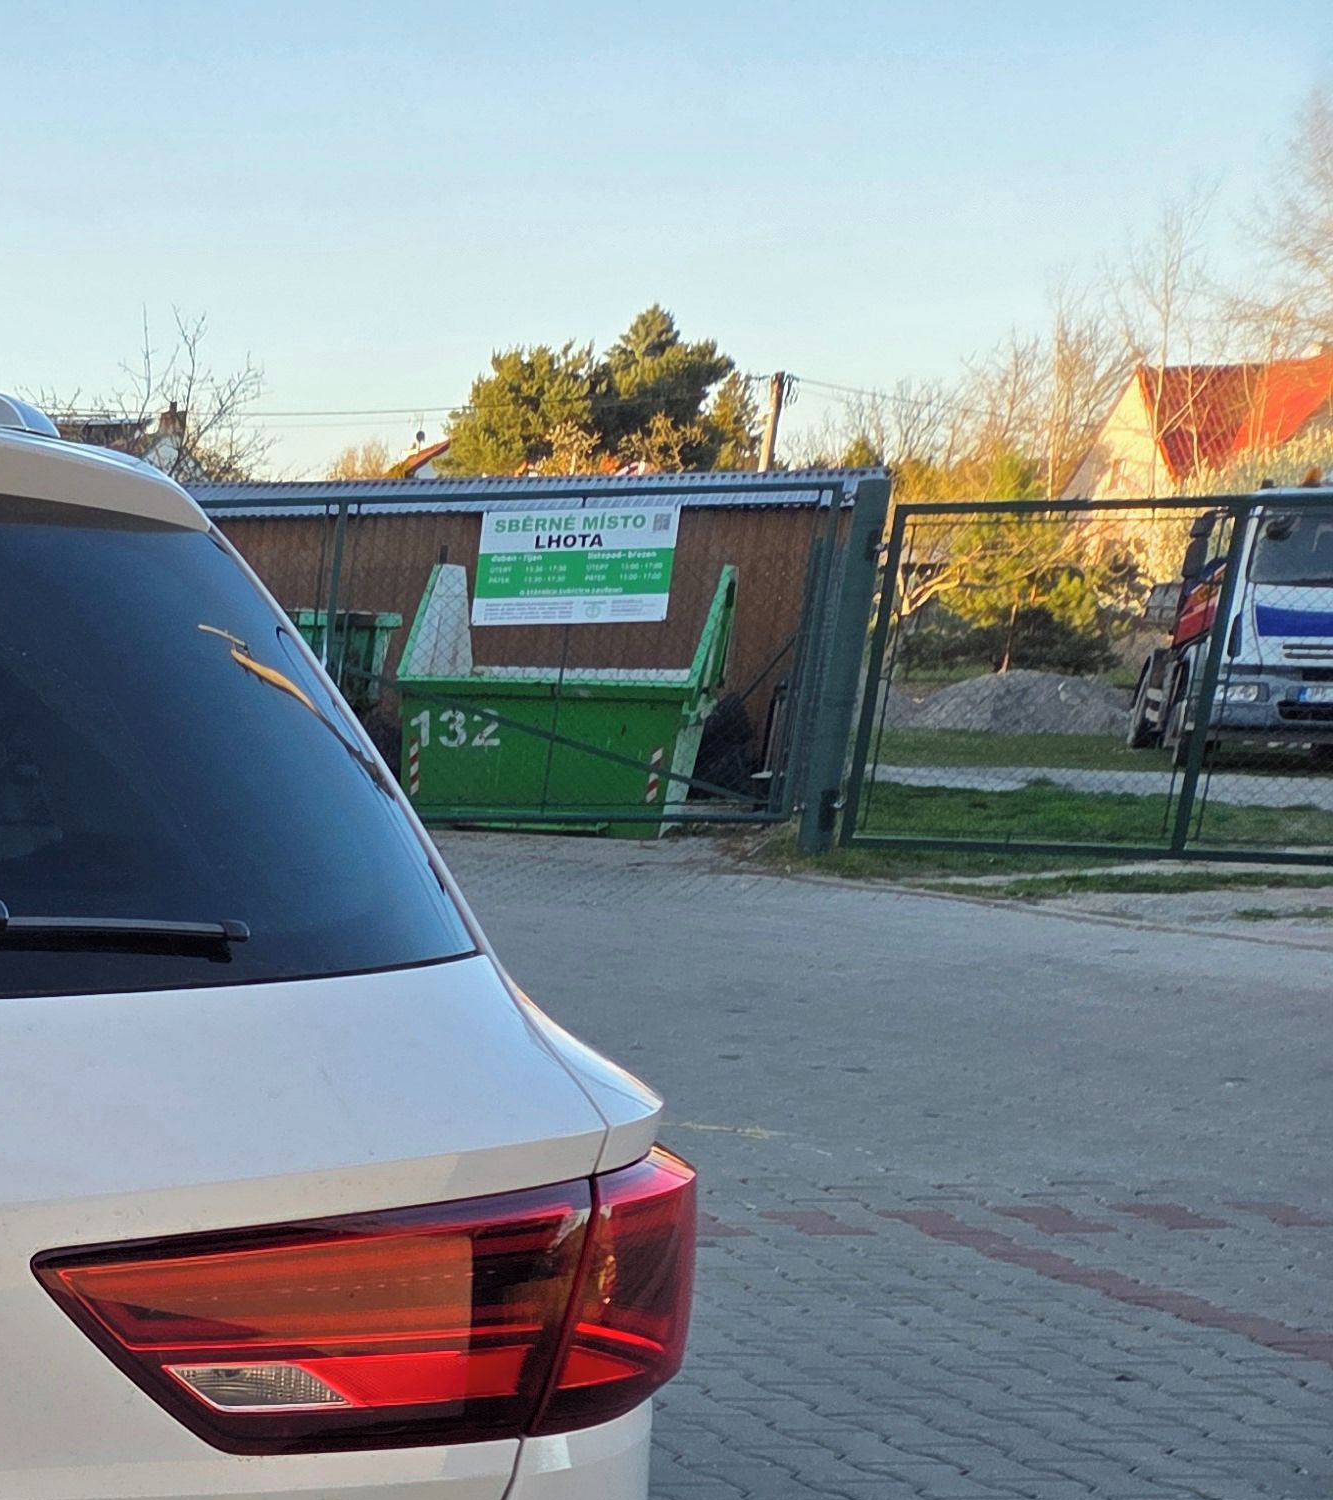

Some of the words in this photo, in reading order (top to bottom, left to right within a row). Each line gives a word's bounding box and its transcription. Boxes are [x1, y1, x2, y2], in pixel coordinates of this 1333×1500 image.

[494, 514, 576, 533] SBĚRNÉ
[583, 512, 646, 530] MÍSTO
[534, 534, 603, 549] LHOTA
[410, 708, 501, 748] 132
